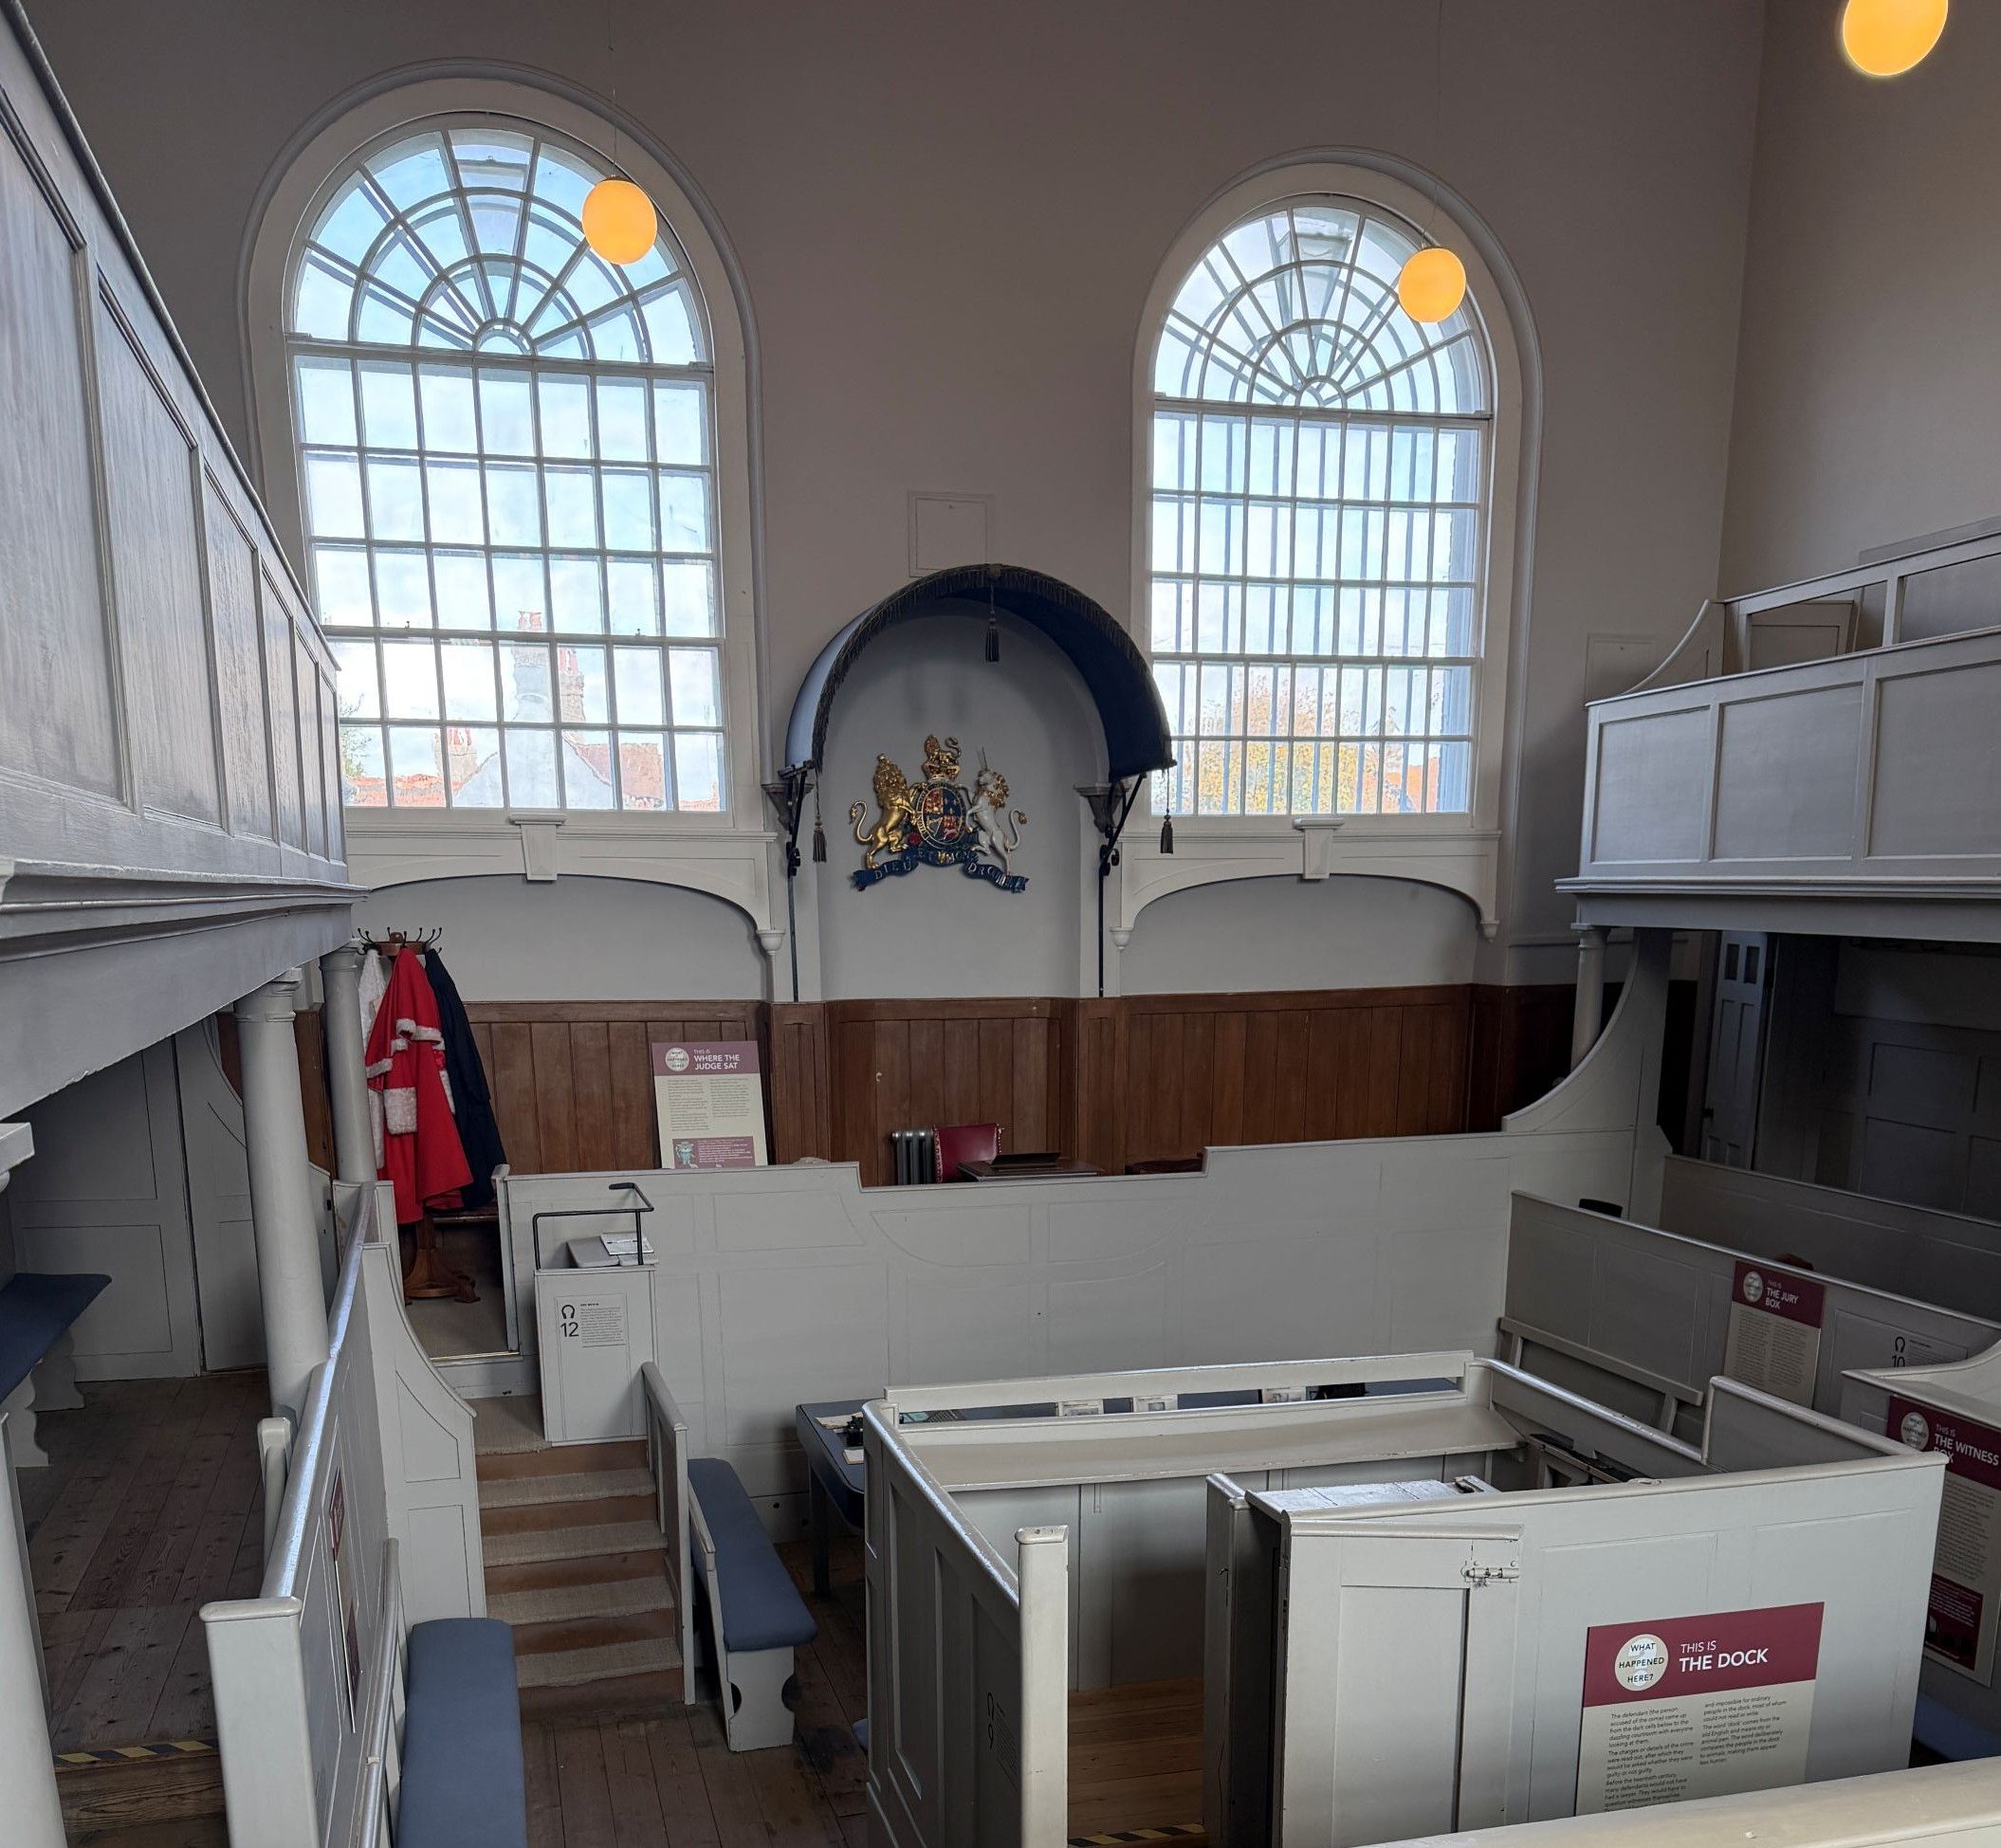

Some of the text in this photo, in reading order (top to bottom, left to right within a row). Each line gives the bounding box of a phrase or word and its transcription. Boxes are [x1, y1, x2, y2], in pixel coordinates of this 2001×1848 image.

[1766, 1297, 1781, 1309] BOX
[1767, 1288, 1781, 1299] THE
[1781, 1290, 1799, 1305] JURY
[560, 1322, 578, 1337] 12
[1935, 1434, 1954, 1449] THE
[1955, 1440, 1999, 1466] WITNESS
[1630, 1642, 1656, 1652] WHAT
[1680, 1640, 1716, 1654] THIS IS
[1618, 1657, 1665, 1669] HAPPENED
[1679, 1648, 1769, 1673] THE DOCK
[1627, 1674, 1654, 1683] HERE?
